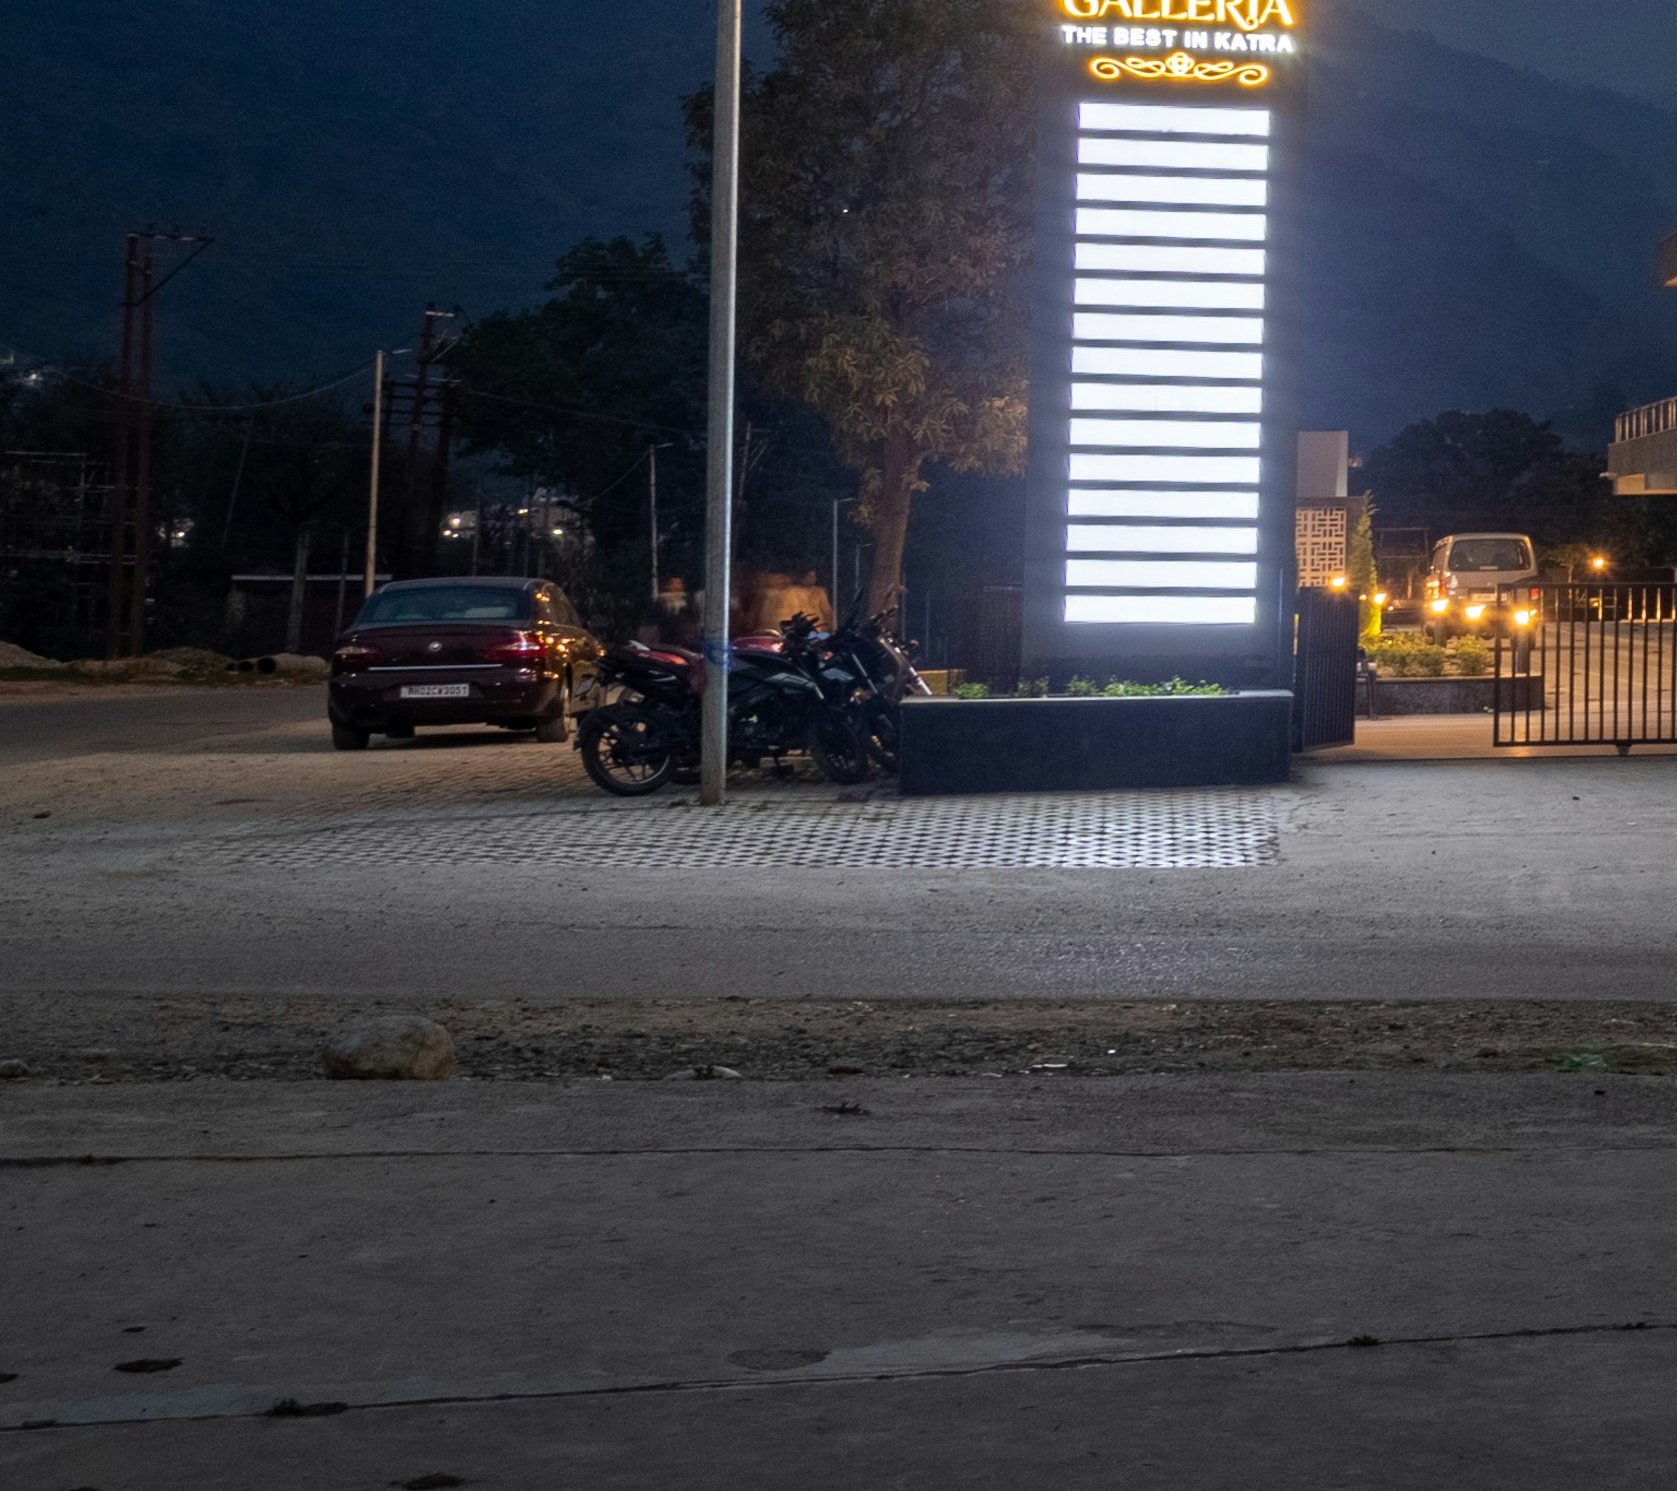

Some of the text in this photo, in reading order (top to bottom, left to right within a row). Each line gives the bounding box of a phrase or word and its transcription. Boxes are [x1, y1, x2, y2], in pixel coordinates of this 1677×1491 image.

[1061, 24, 1294, 53] THE BEST IN KATRA
